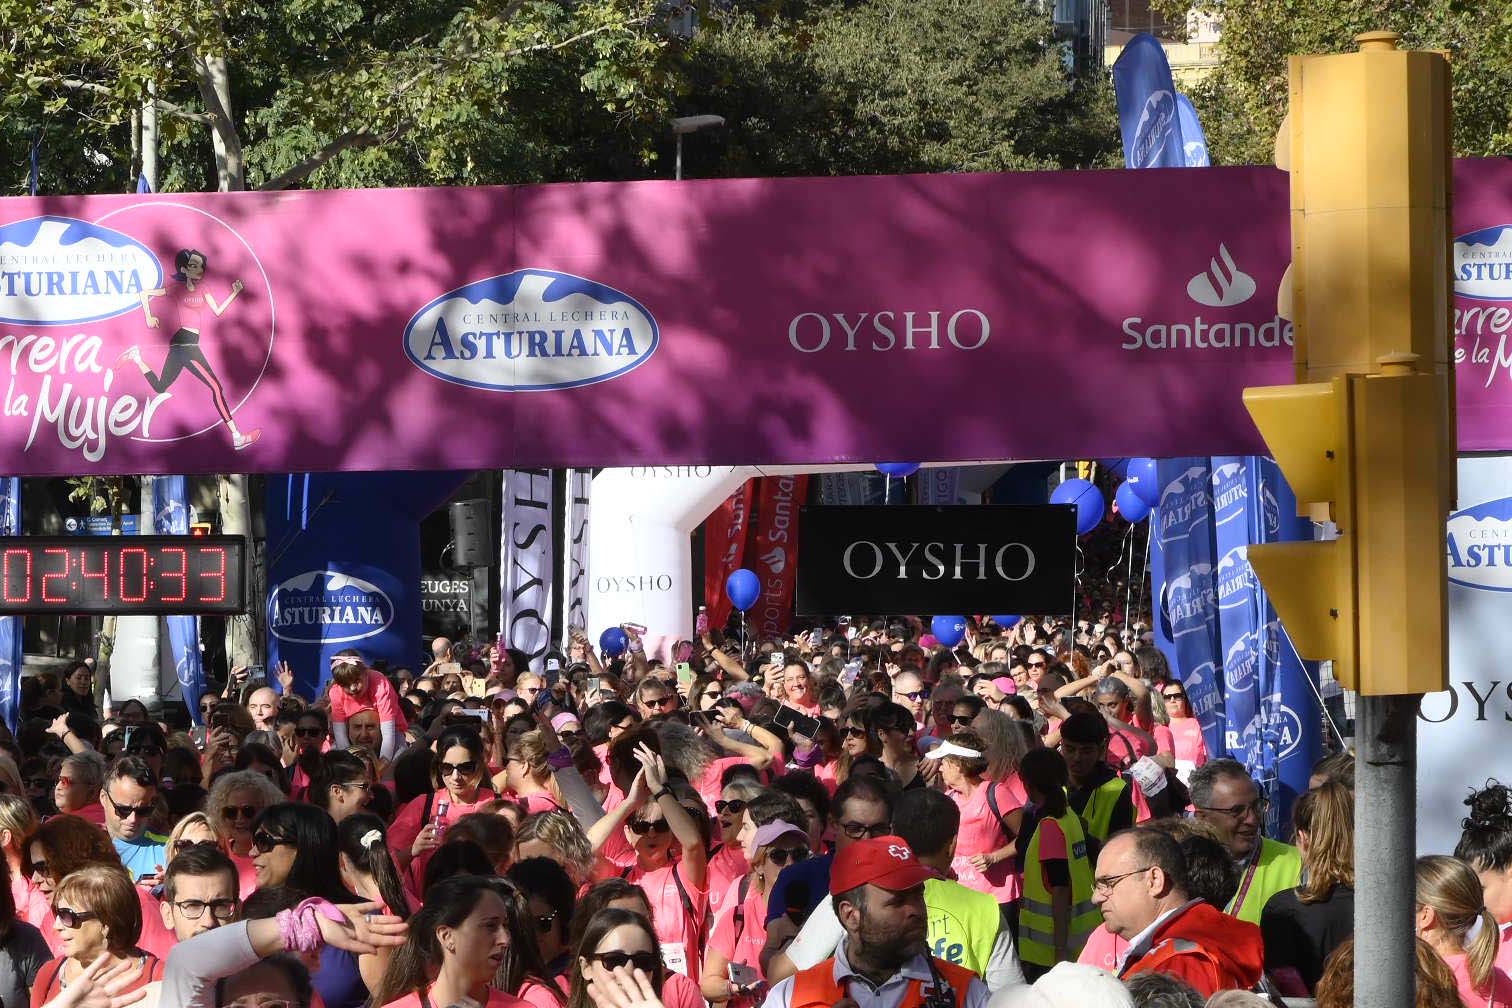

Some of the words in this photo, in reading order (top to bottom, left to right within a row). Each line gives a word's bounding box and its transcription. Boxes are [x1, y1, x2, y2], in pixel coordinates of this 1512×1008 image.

[463, 310, 541, 325] CENTRAL
[548, 309, 630, 323] LECHERA
[789, 308, 990, 353] OYSHO
[1122, 314, 1294, 350] Santande
[424, 317, 639, 361] ASTURIANA
[4, 378, 29, 418] la
[25, 369, 173, 462] Mujer
[769, 474, 794, 543] Santa
[3, 548, 225, 602] 02:40:33
[842, 540, 1036, 582] OYSHO
[596, 574, 672, 594] OYSHO
[273, 603, 385, 627] ASTURIANA
